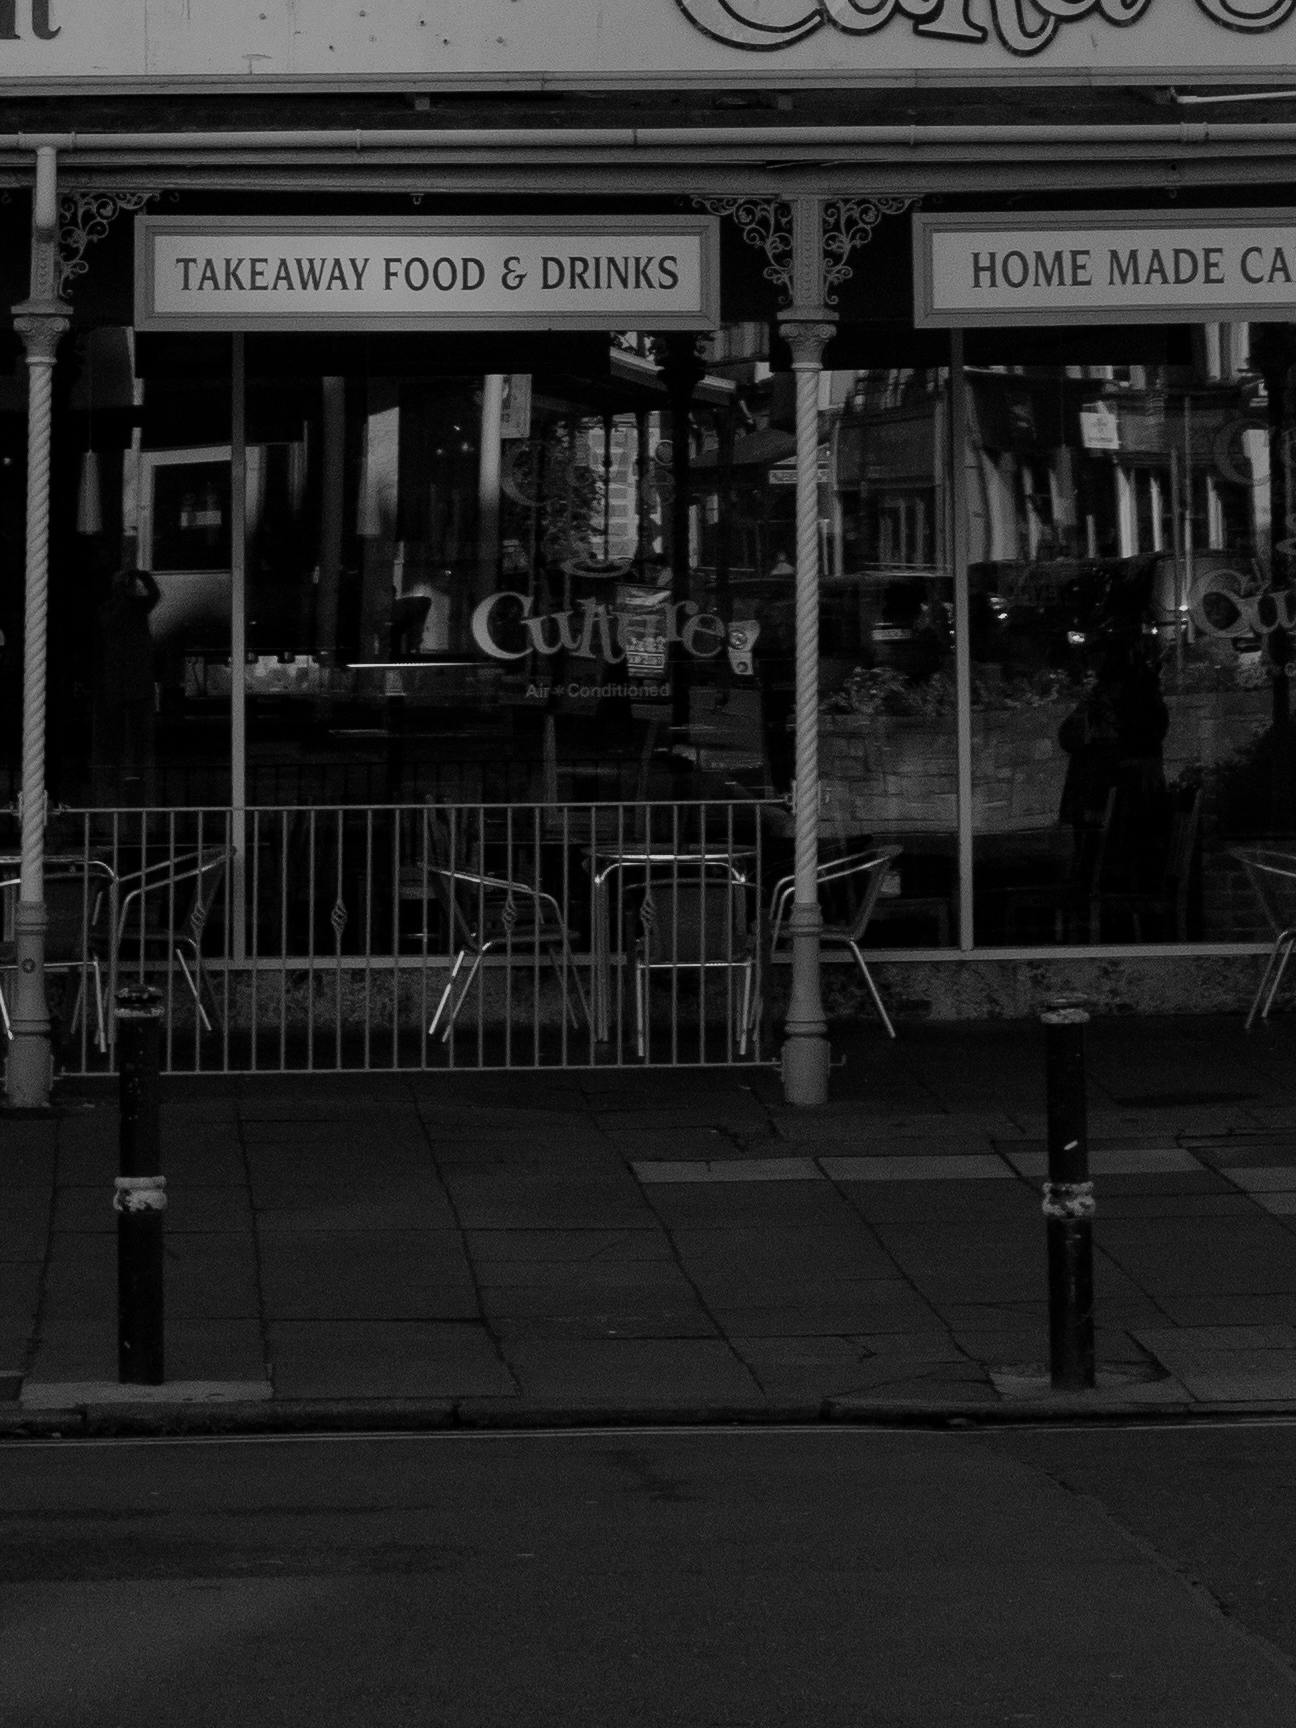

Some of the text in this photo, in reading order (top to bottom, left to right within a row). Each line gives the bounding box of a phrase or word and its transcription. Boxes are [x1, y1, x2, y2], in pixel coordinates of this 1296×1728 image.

[175, 255, 680, 292] TAKEAWAY FOOD & DRINKS
[971, 250, 1093, 289] HOME
[1107, 248, 1225, 286] MADE
[471, 591, 727, 666] Culture
[526, 682, 672, 699] Air Conditioned
